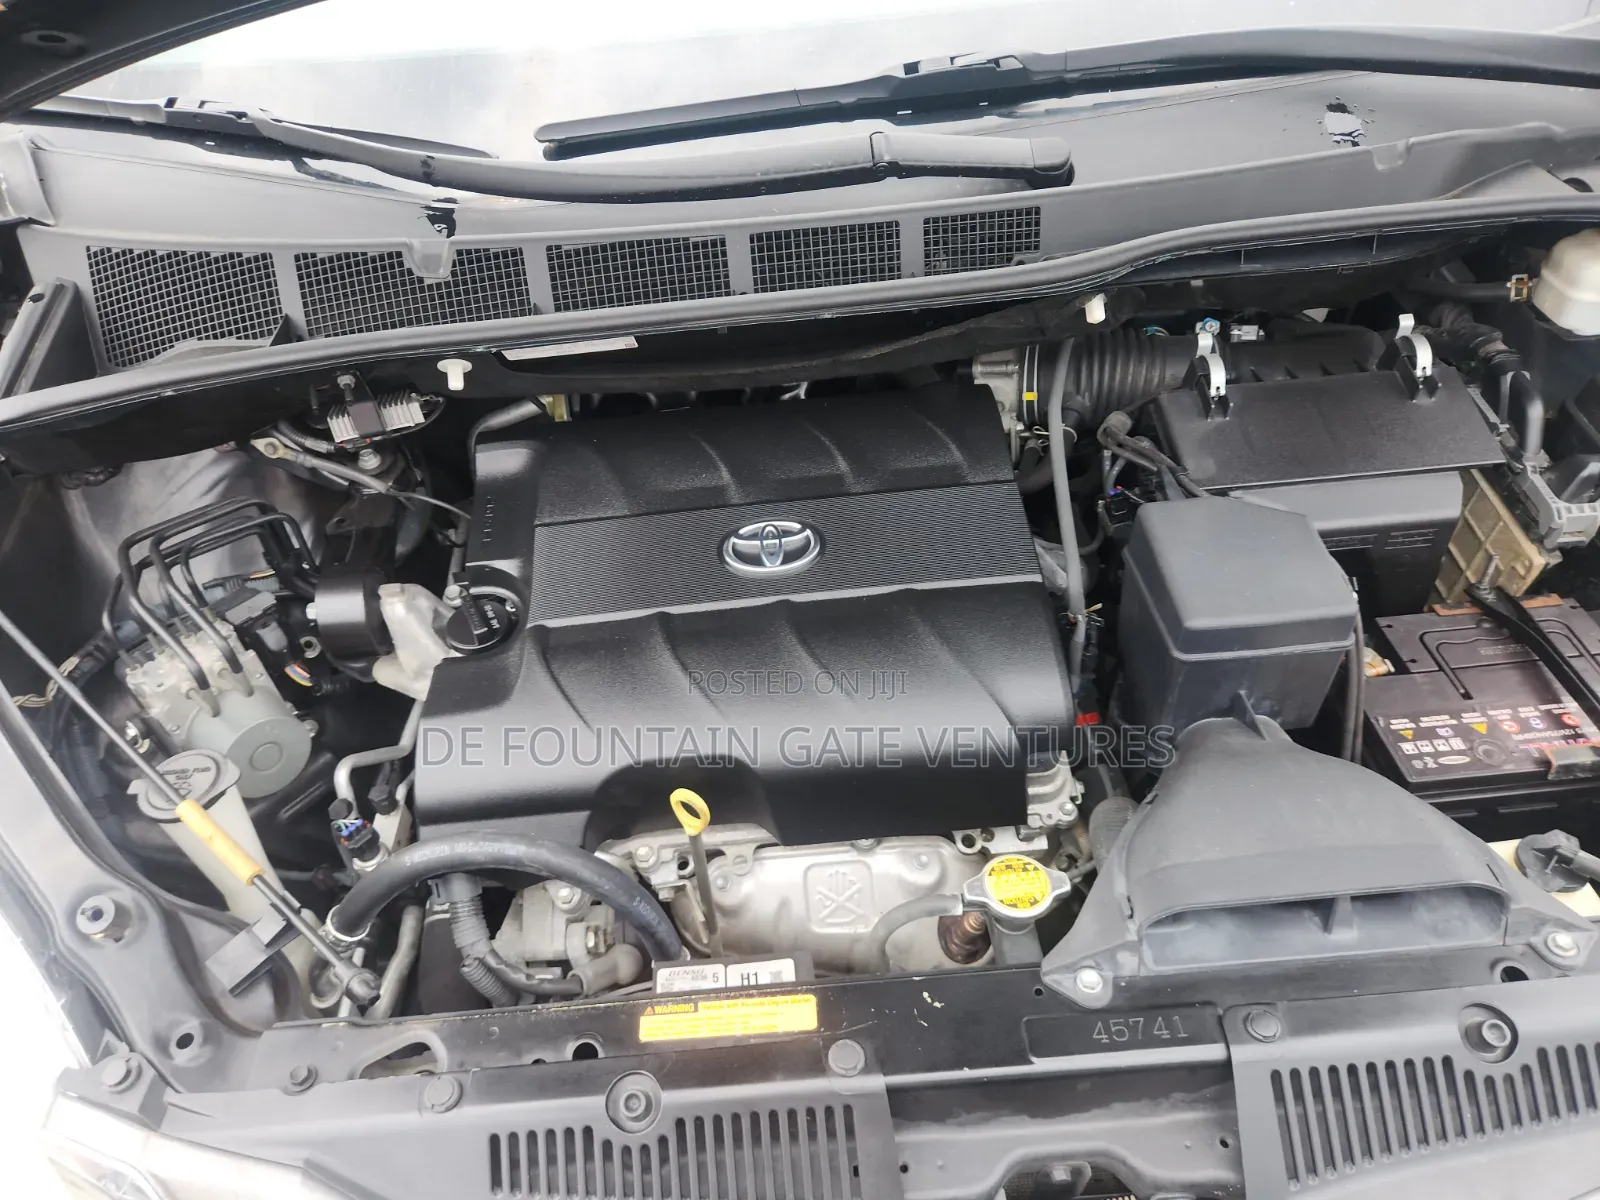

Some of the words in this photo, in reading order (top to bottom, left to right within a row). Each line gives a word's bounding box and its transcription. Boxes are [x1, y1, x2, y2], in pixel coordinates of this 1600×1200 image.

[712, 972, 720, 983] 5
[740, 972, 760, 986] H1
[654, 1003, 695, 1014] WARNING
[1092, 1015, 1189, 1043] 45741
